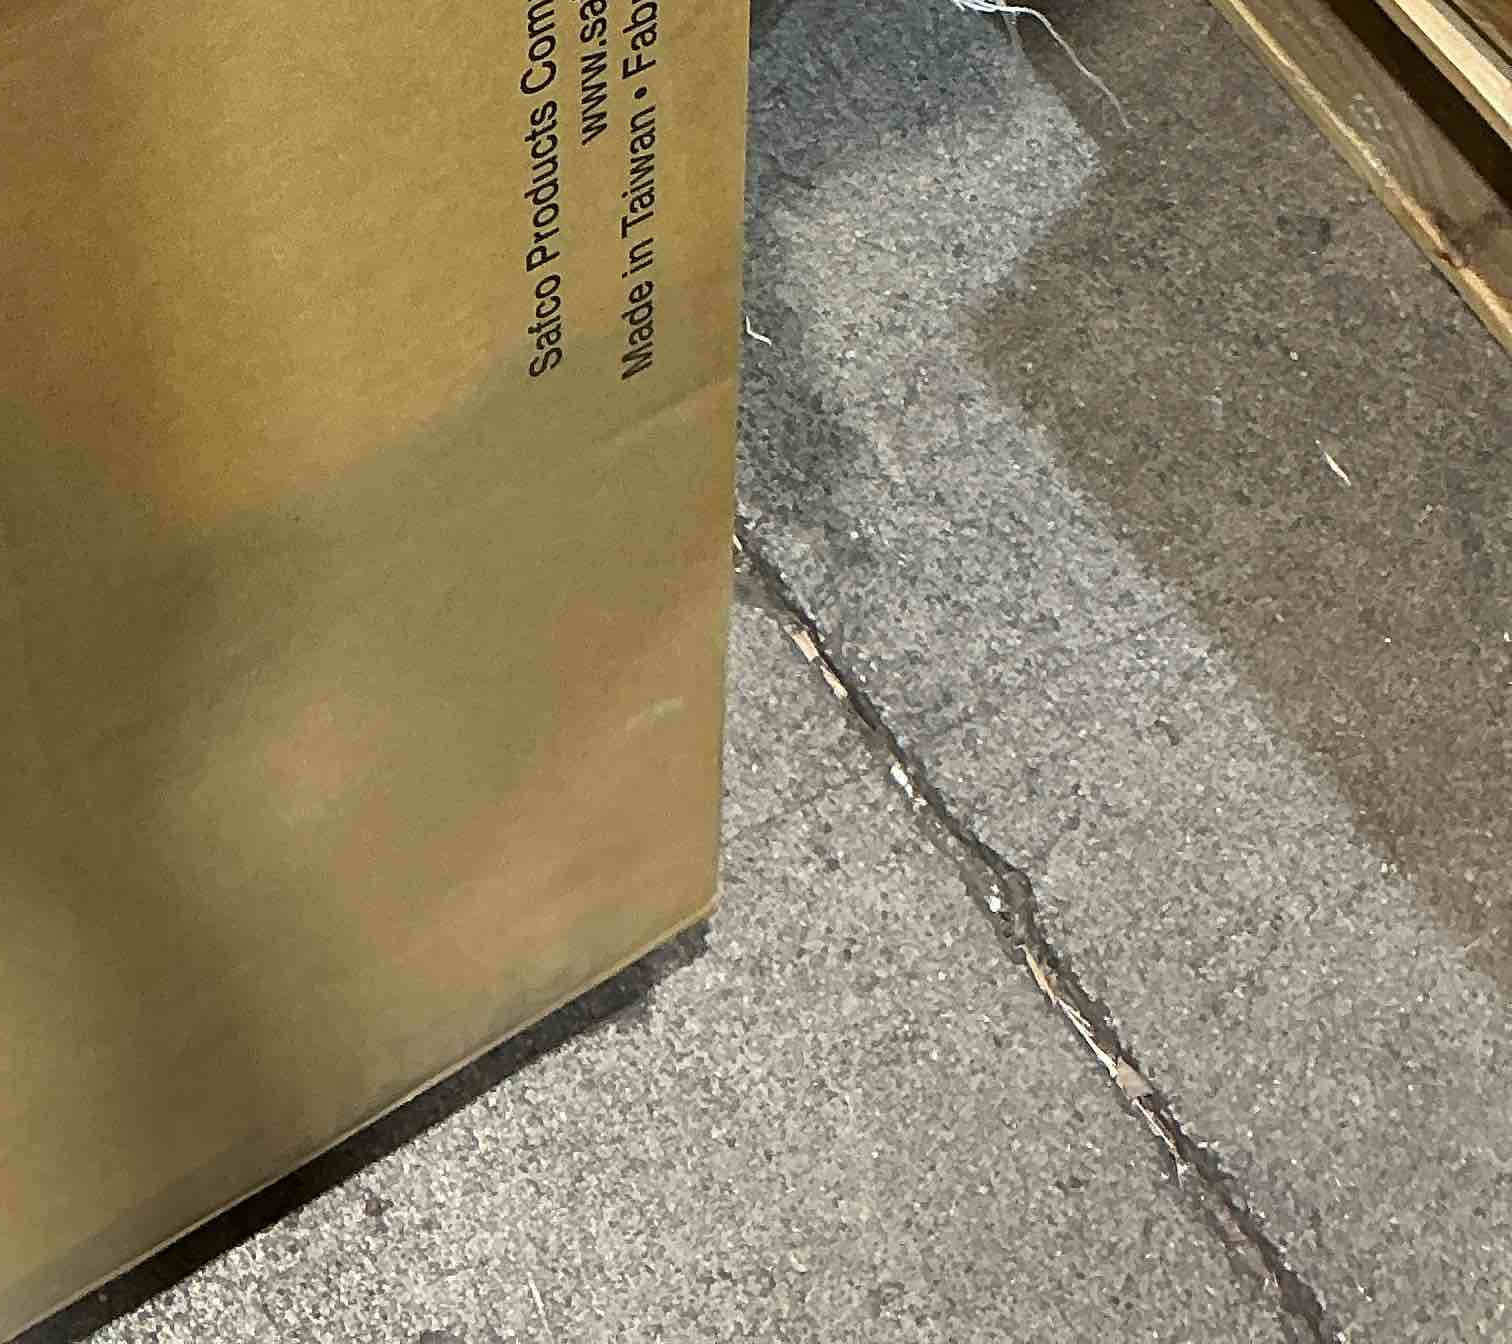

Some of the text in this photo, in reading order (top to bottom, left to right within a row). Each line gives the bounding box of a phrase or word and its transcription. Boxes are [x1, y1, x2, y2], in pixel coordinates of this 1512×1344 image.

[524, 99, 563, 270] Products
[620, 102, 657, 236] Taiwan
[621, 236, 656, 278] in
[527, 272, 564, 377] Safco
[621, 281, 656, 380] Made
